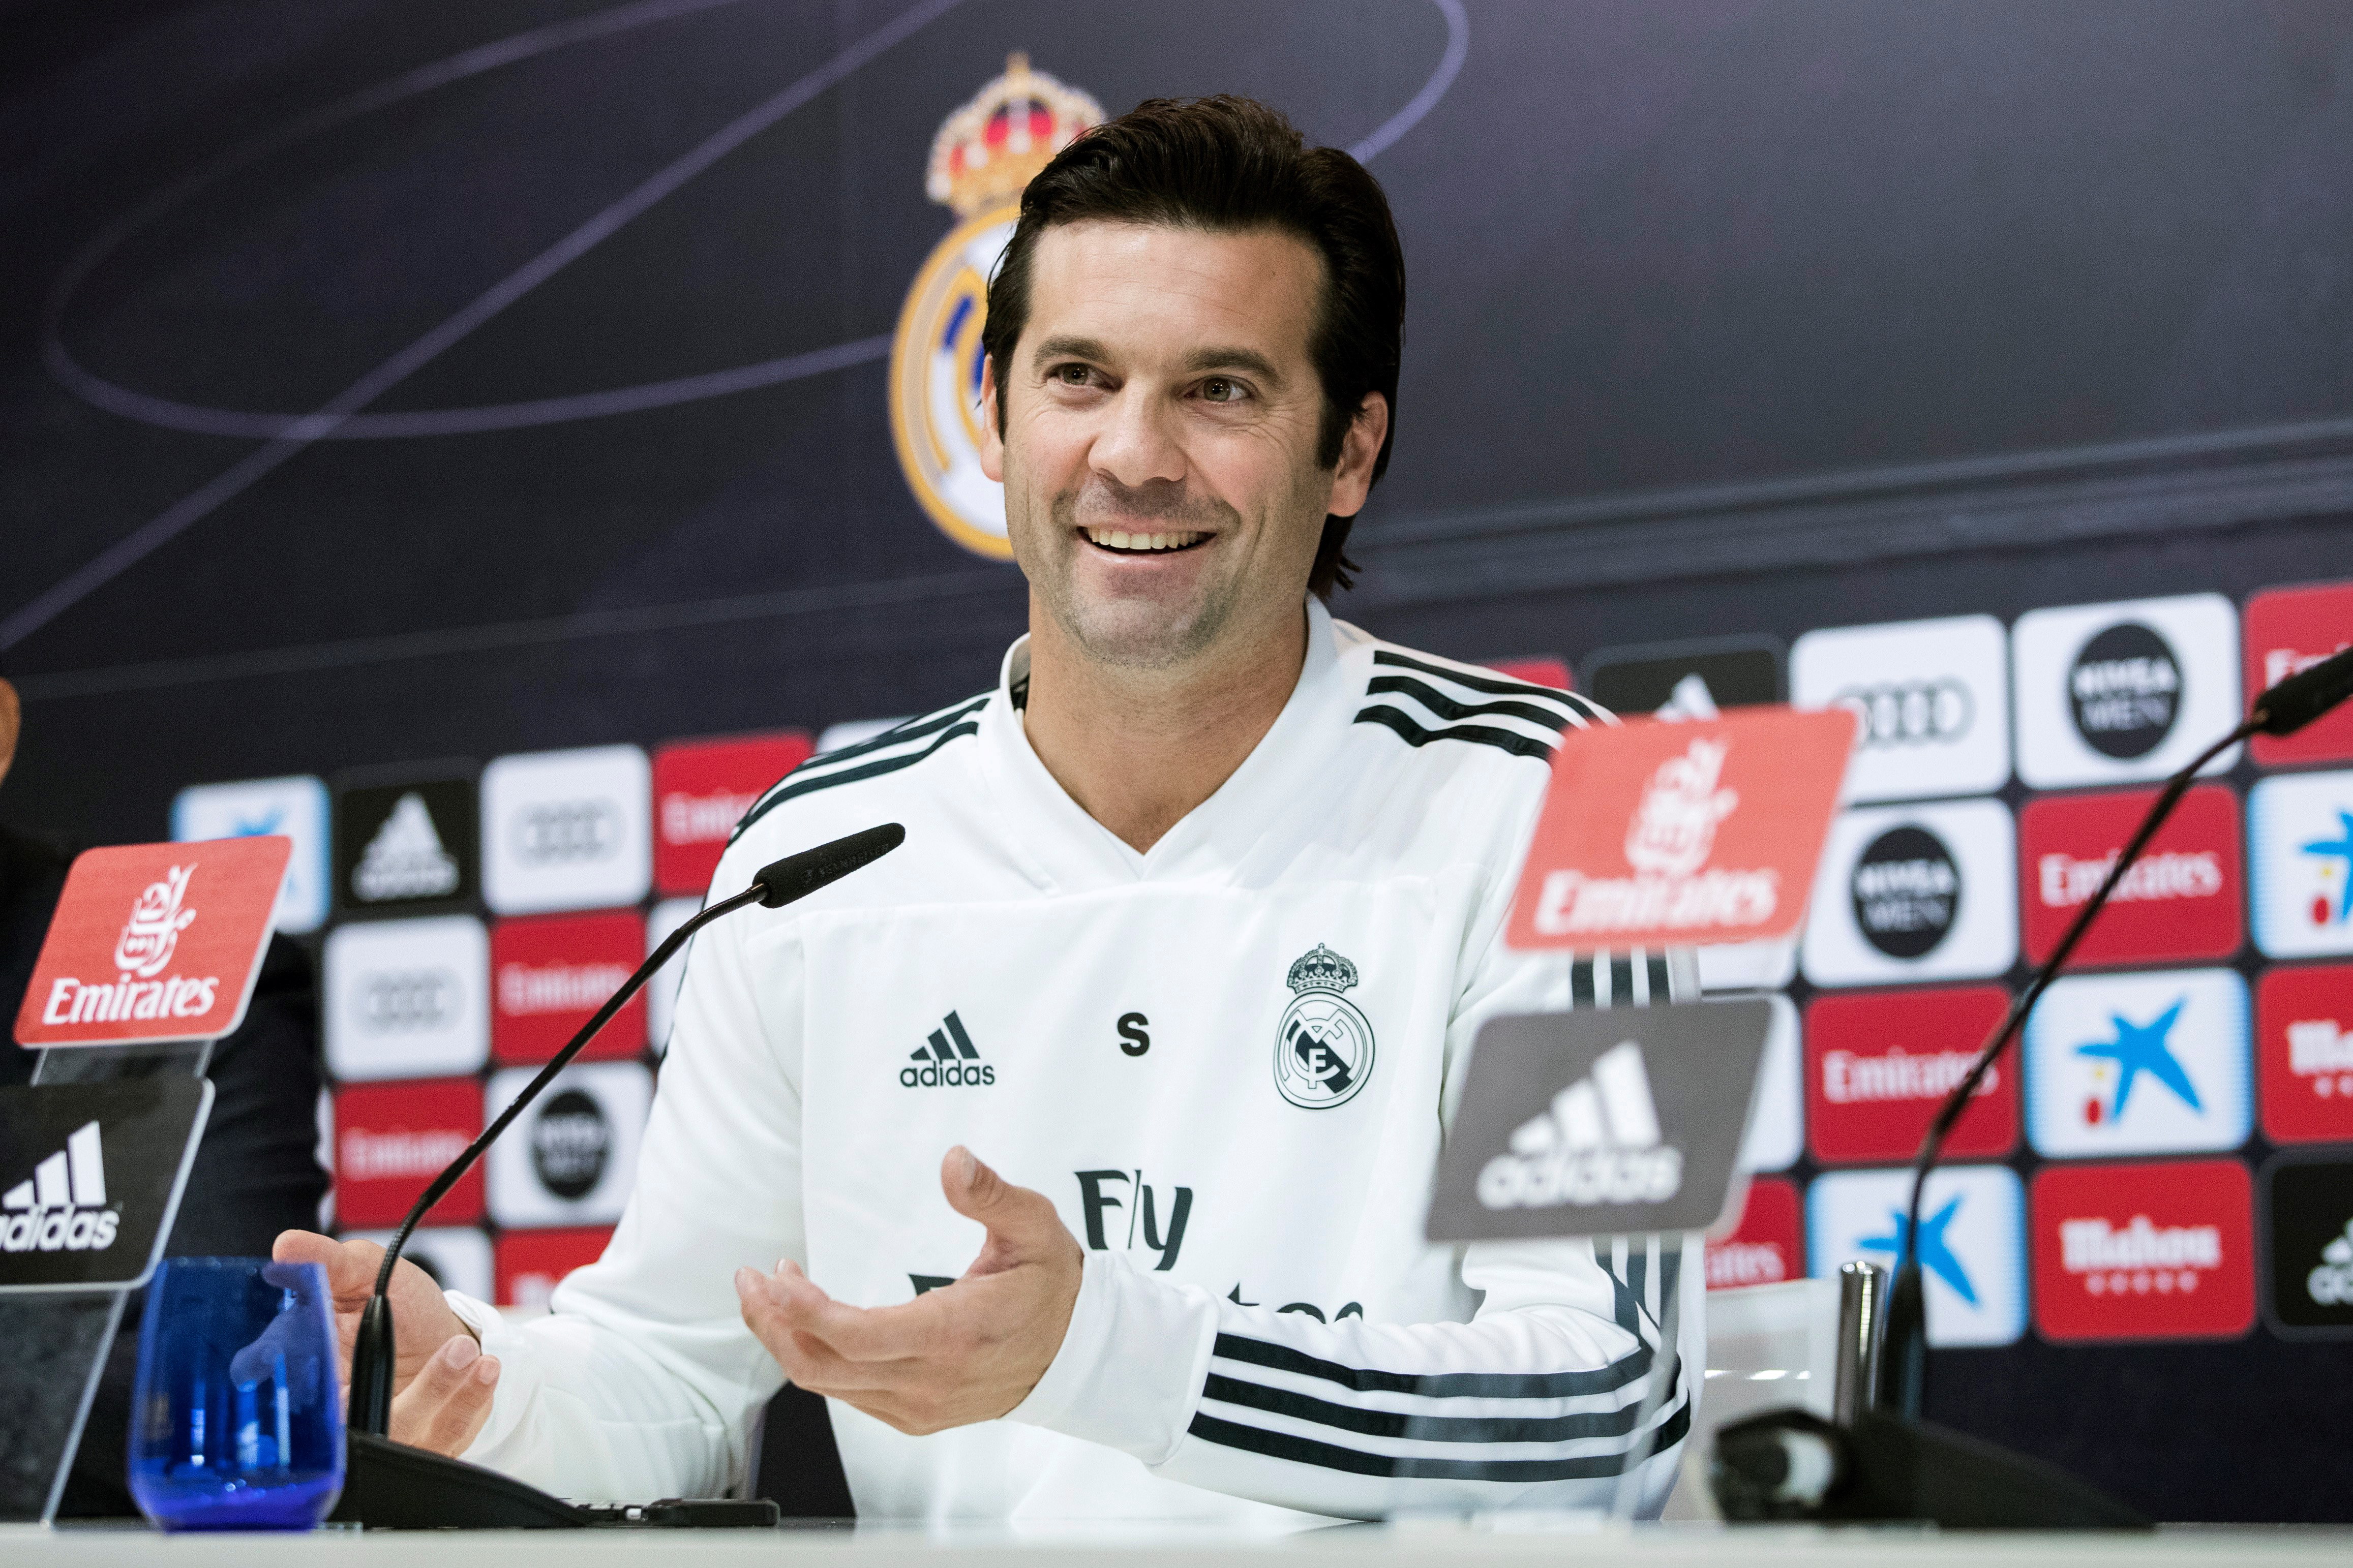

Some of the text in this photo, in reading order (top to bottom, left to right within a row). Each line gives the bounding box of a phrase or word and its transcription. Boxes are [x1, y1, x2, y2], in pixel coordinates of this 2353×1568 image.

[1533, 867, 1783, 936] Emirates
[42, 972, 219, 1025] Emirates
[1117, 1012, 1151, 1057] S
[899, 1058, 995, 1088] adidas
[1476, 1145, 1685, 1211] adidas
[1073, 1169, 1193, 1271] Fly
